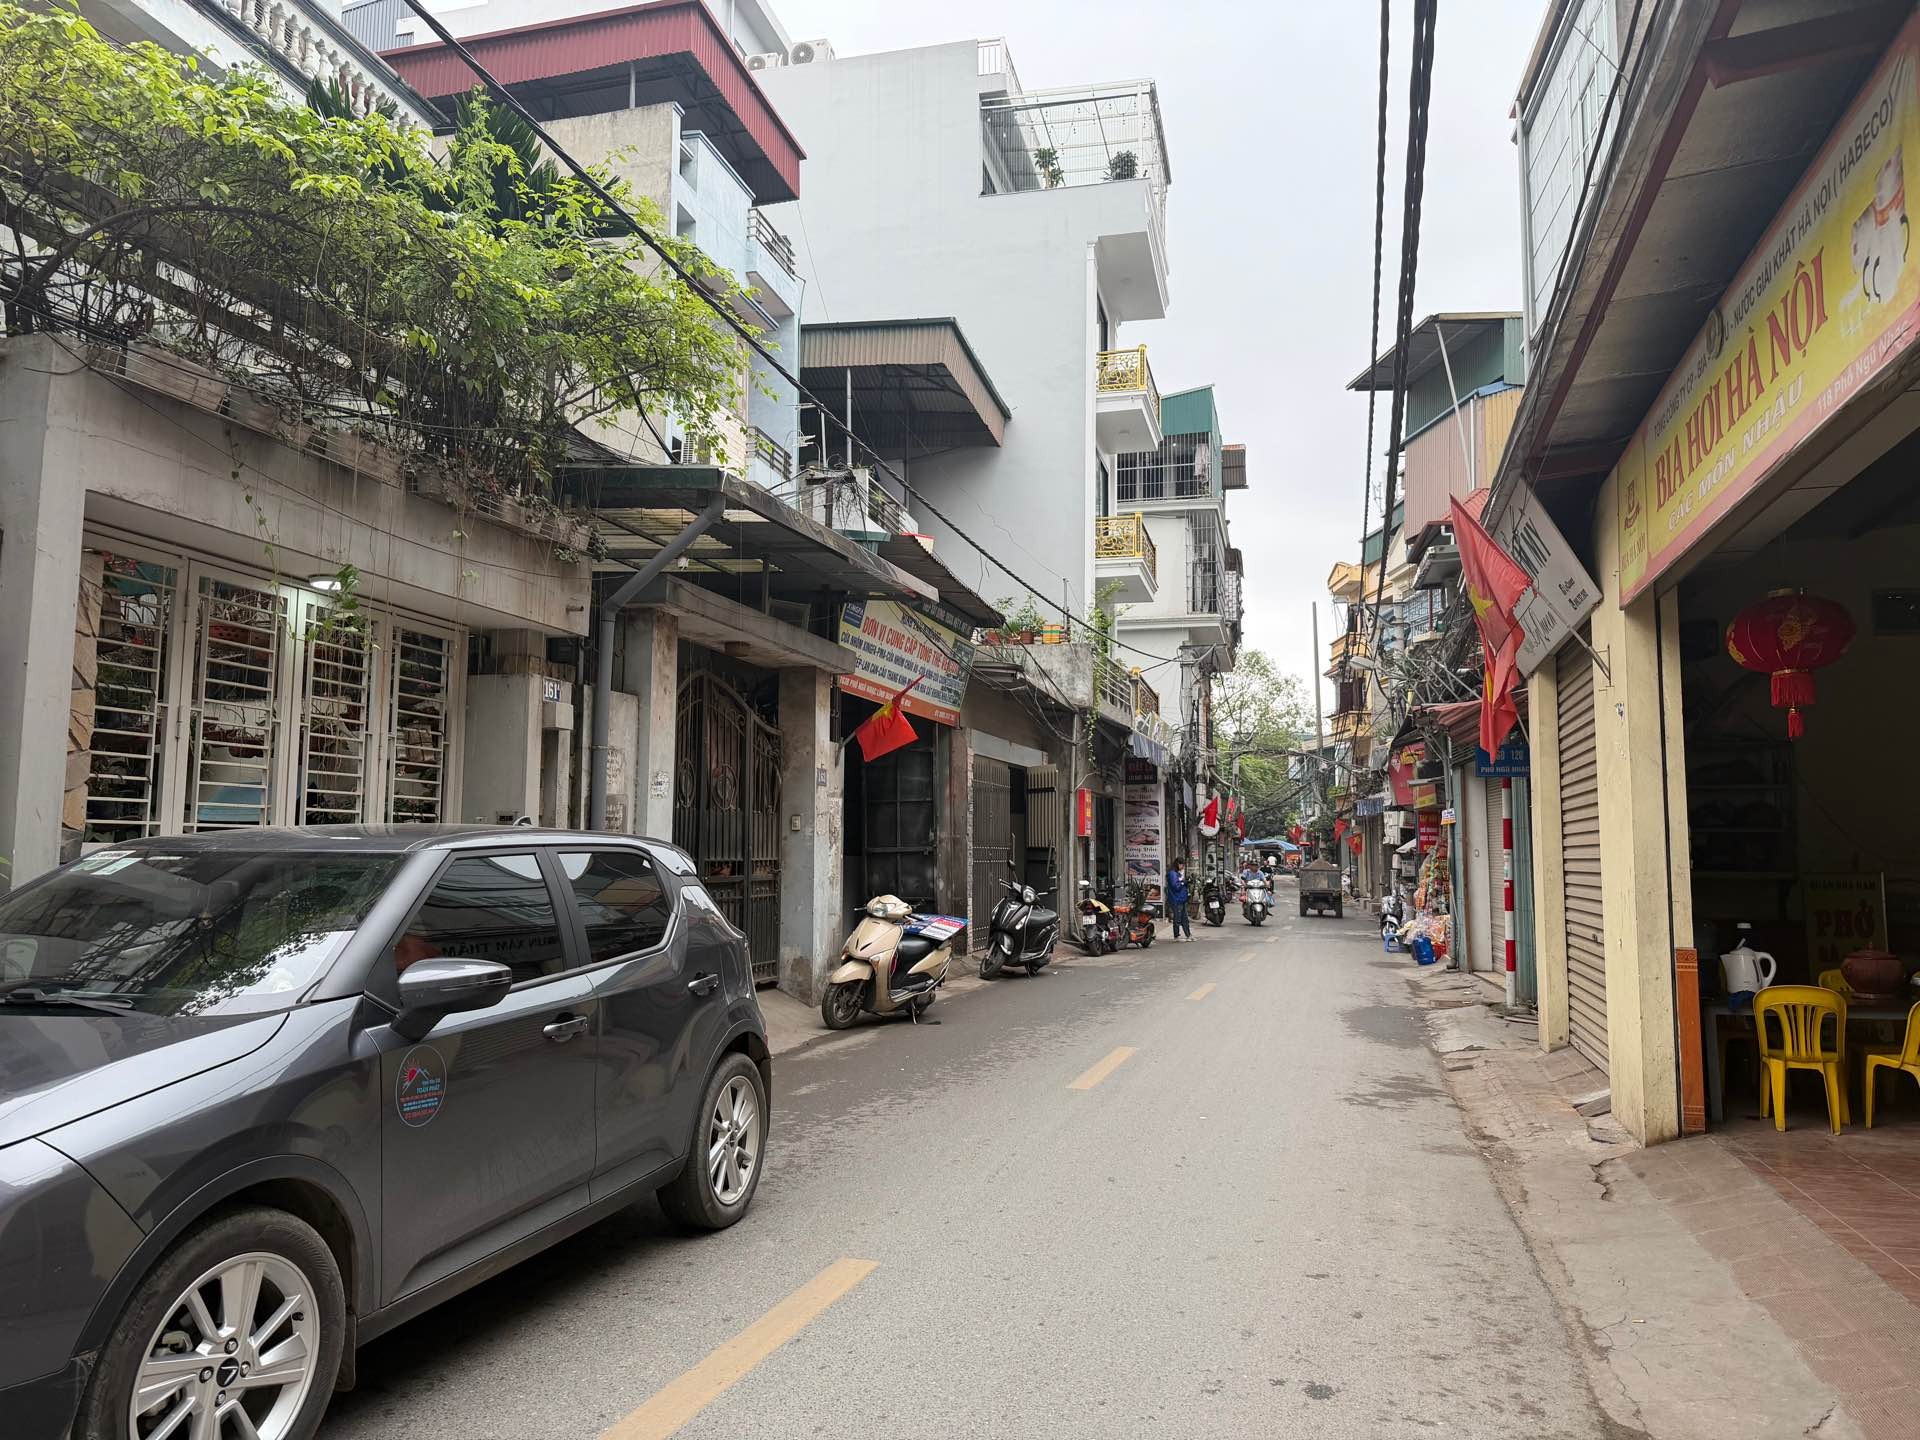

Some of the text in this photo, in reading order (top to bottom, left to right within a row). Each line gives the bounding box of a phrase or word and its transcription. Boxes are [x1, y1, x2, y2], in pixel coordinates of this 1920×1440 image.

[1773, 226, 1797, 276] KHÁT
[1798, 203, 1812, 241] HÀ
[1813, 178, 1832, 222] NỘI
[1655, 246, 1828, 512] BIA HƠI HÀ NỘI
[1668, 489, 1696, 532] CÁC
[1743, 372, 1805, 456] NHẬU
[861, 615, 879, 640] ĐƠN
[878, 623, 887, 646] VỊ
[886, 626, 904, 649] CUNG
